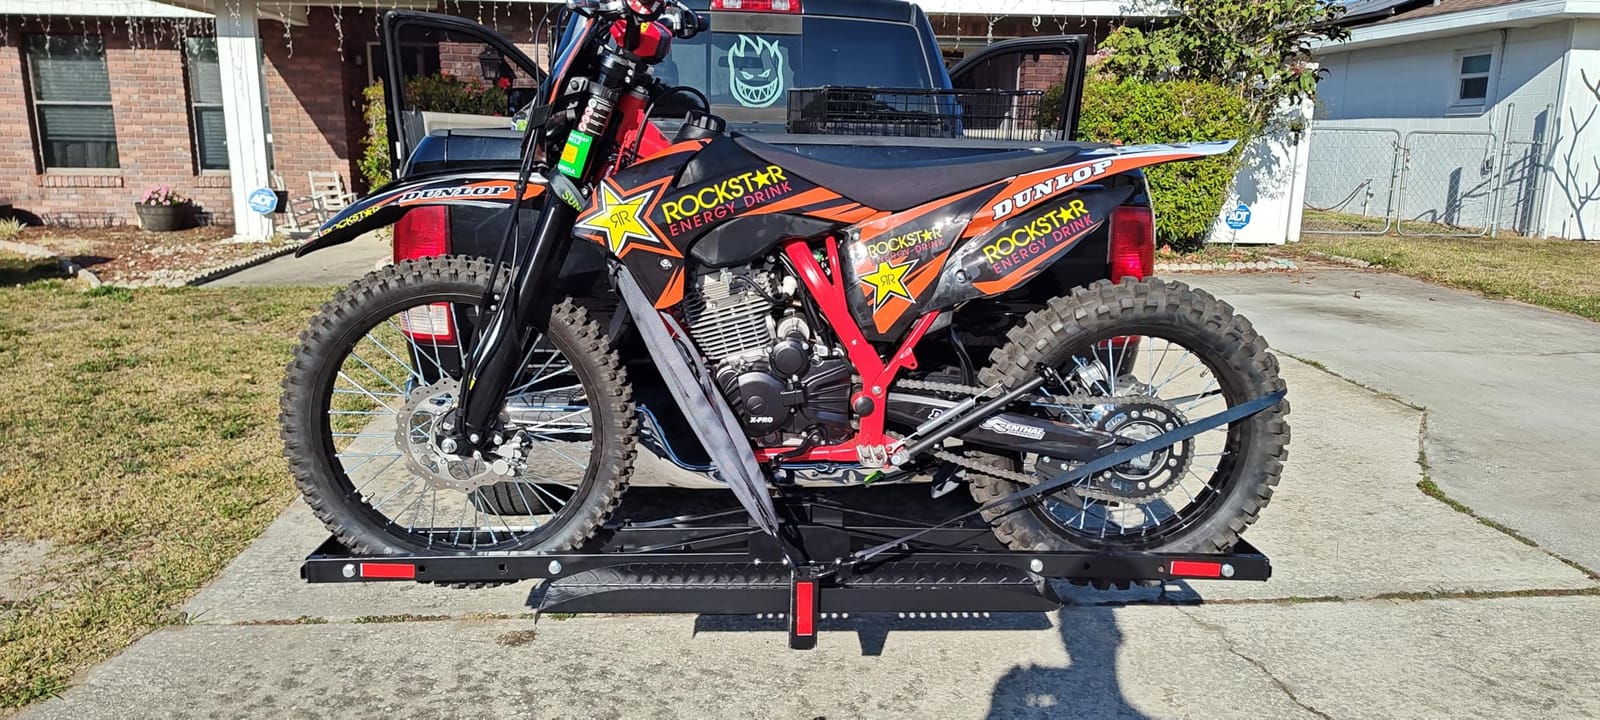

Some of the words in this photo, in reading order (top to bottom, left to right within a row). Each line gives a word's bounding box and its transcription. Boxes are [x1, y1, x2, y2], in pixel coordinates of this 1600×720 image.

[250, 193, 276, 207] ADT
[399, 186, 510, 202] DUNLOP
[661, 165, 787, 225] ROCKSTAR
[669, 203, 736, 238] ENERGY
[744, 180, 792, 208] DRINK
[992, 159, 1113, 220] DUNLOP
[983, 199, 1089, 264] ROCKSTAR
[1228, 211, 1249, 222] ADT
[873, 248, 910, 265] NERGY
[914, 238, 945, 254] DRINK
[992, 239, 1048, 275] ENERGY
[1054, 214, 1095, 243] DRINK
[749, 416, 774, 424] X-PRO
